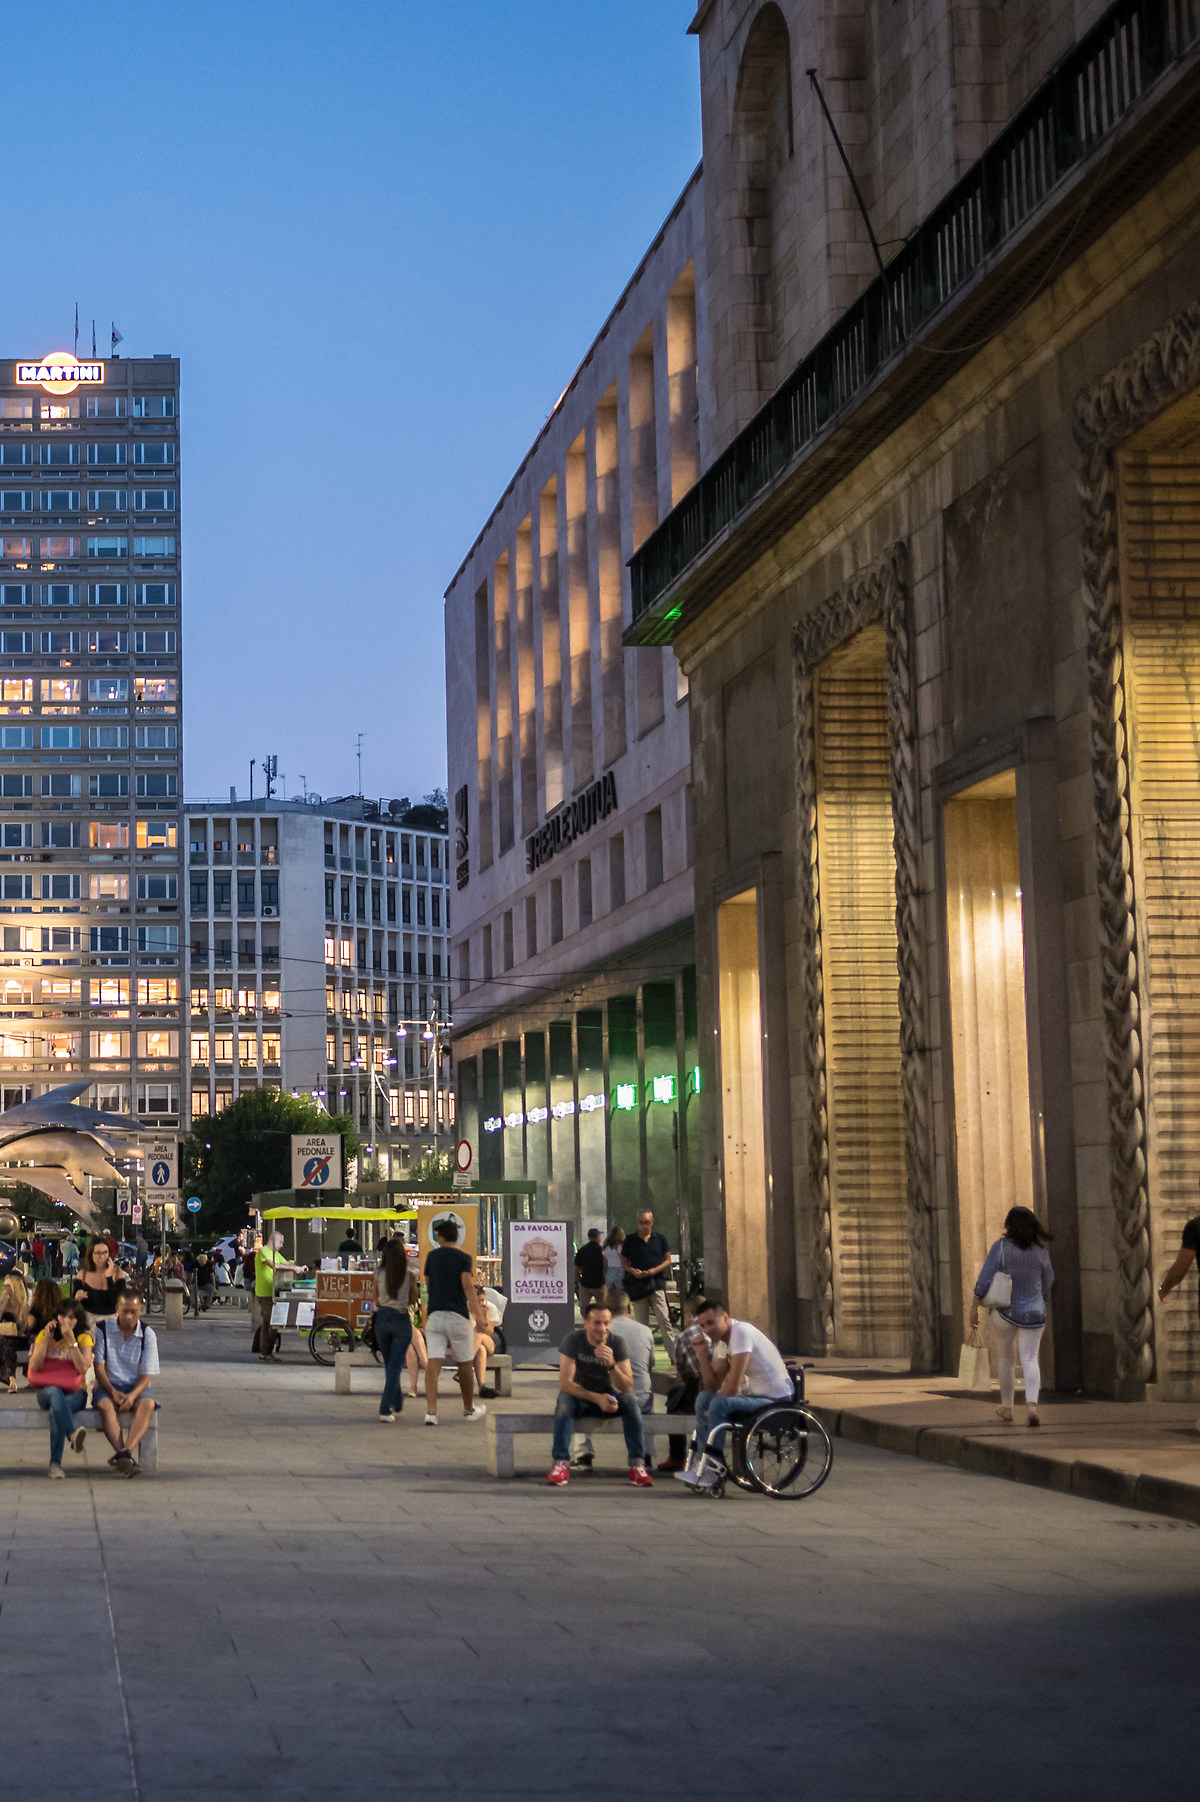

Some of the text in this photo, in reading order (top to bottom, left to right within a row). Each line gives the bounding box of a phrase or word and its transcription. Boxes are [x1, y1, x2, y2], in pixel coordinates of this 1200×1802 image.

[21, 366, 99, 381] MARTINI
[526, 770, 618, 874] REALE MUTUA
[306, 1138, 326, 1146] AREA
[153, 1145, 168, 1153] AREA
[297, 1147, 335, 1156] PEDONALE
[147, 1152, 174, 1161] PEDONALE
[147, 1192, 166, 1200] eccetto
[514, 1224, 562, 1232] DA FAVOLA!
[515, 1280, 564, 1288] CASTELLO
